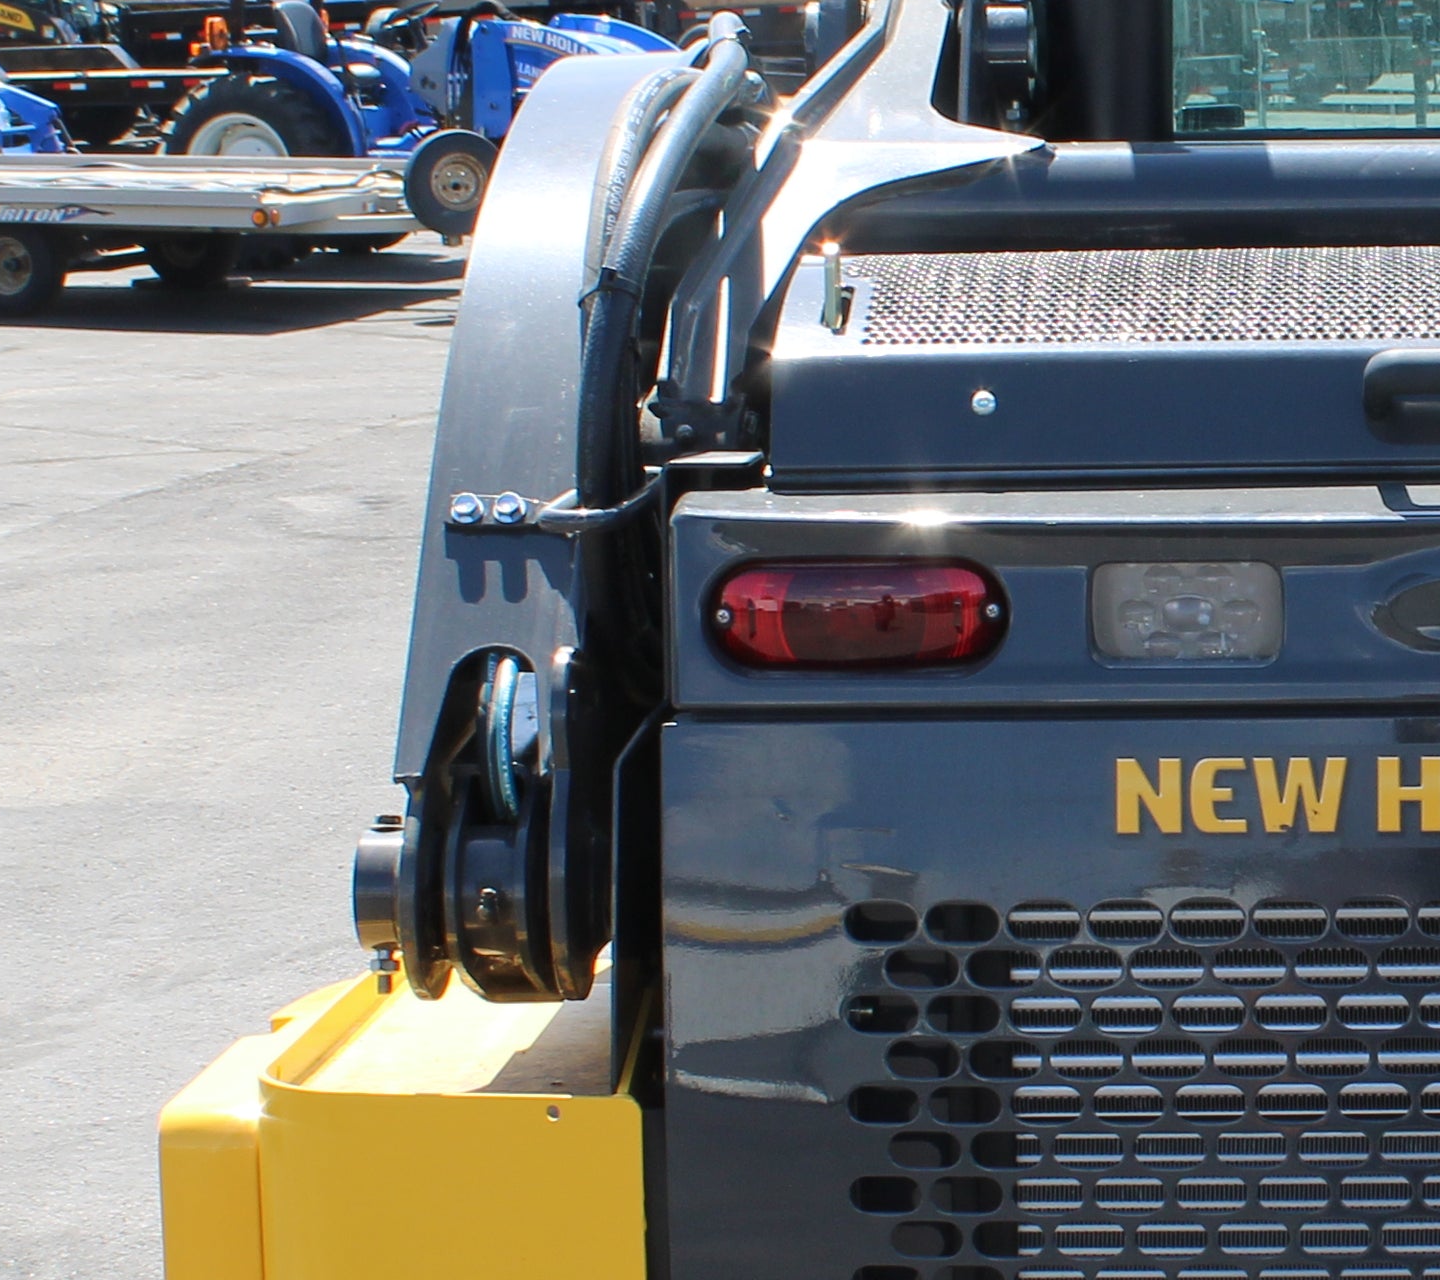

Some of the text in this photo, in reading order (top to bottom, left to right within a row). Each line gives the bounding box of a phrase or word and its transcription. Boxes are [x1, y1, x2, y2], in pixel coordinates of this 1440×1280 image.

[511, 25, 599, 55] NEW HOLLA
[1114, 755, 1348, 835] NEW
